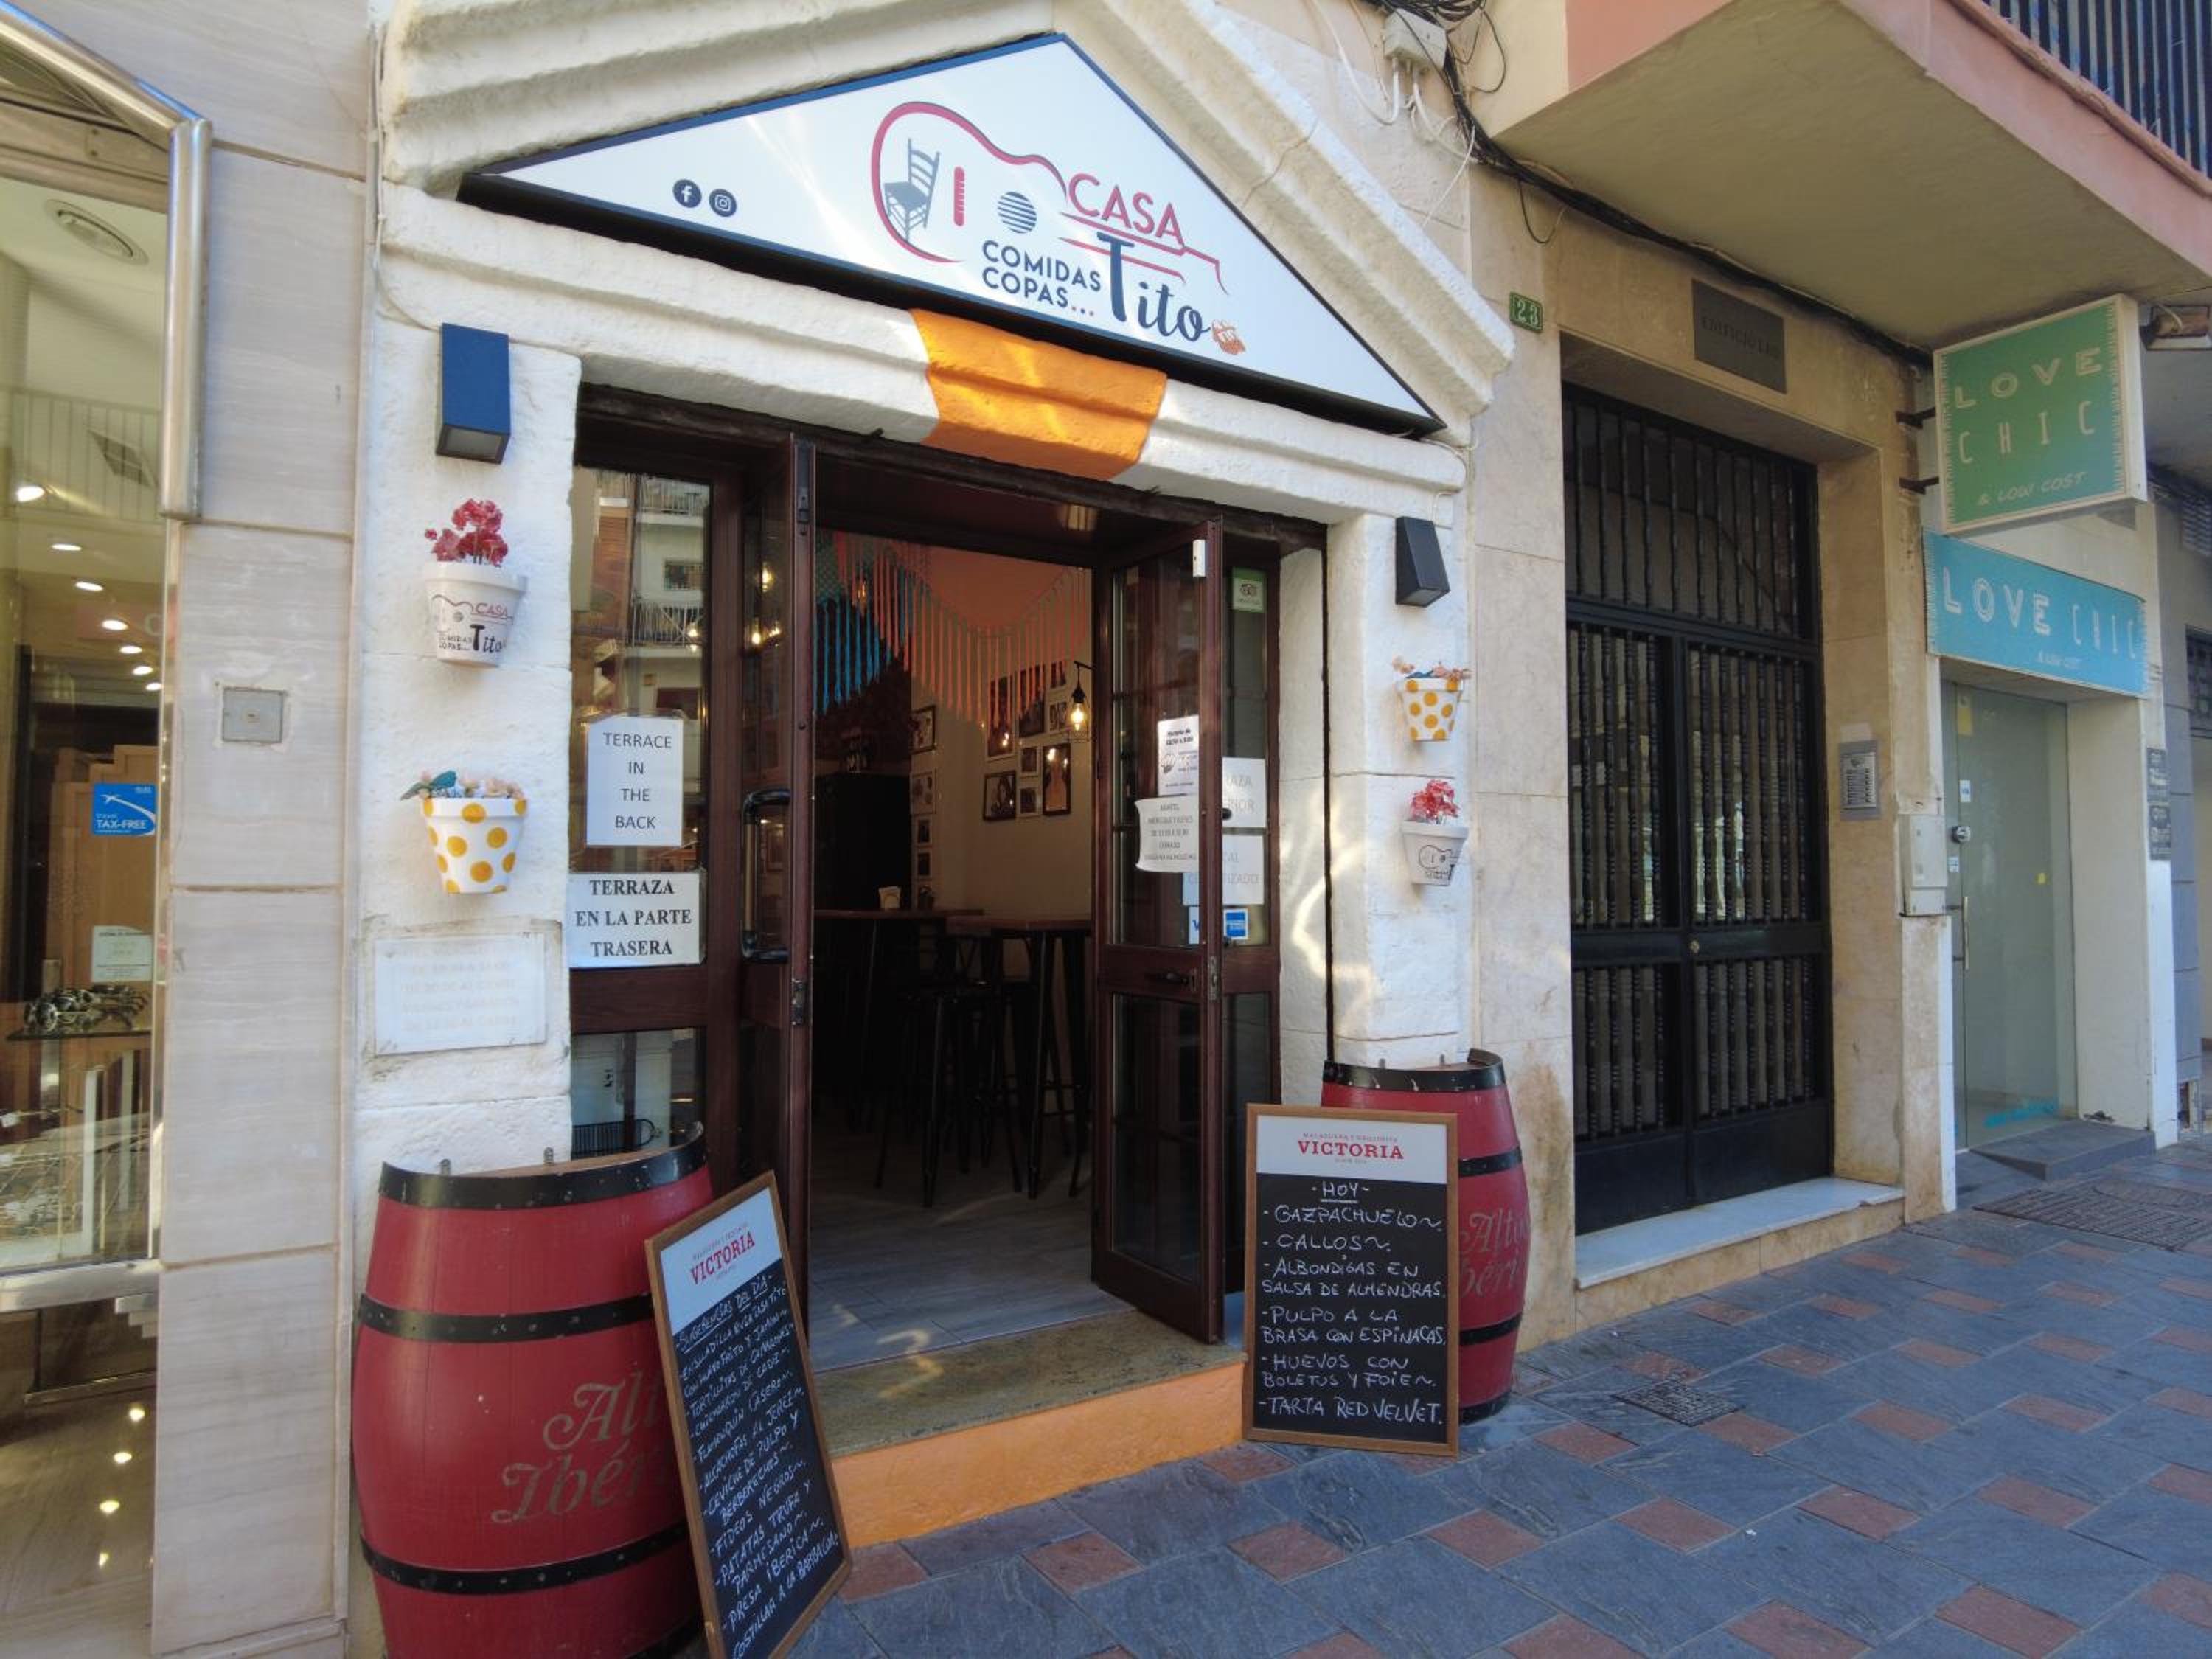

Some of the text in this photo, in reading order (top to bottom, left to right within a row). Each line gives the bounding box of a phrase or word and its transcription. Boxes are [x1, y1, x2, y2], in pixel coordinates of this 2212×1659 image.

[1069, 173, 1184, 248] CASA
[983, 240, 1101, 291] COMIDAS
[1096, 232, 1210, 341] Tito
[1955, 348, 2101, 409] LOVE
[1959, 401, 2095, 463] CHIC
[1997, 484, 2035, 503] LOW
[2040, 472, 2087, 493] COST
[476, 602, 508, 617] CASA
[1943, 566, 2137, 659] LOVE CHIC
[602, 732, 672, 748] TERRACE
[628, 762, 644, 774] IN
[620, 788, 650, 802] THE
[97, 819, 147, 830] TAX-FREE
[615, 815, 656, 830] BACK
[590, 879, 675, 896] TERRAZA
[575, 909, 692, 927] EN LA PARTE
[591, 940, 673, 958] TRASERA
[1298, 1141, 1404, 1160] VICTORIA
[1277, 1234, 1362, 1251] CALLOS
[691, 1231, 755, 1284] VICTORIA
[1387, 1262, 1418, 1276] EN
[1262, 1279, 1312, 1295] SALSA
[1321, 1281, 1339, 1295] DE
[1345, 1309, 1357, 1322] A
[1370, 1309, 1399, 1322] LA
[1262, 1326, 1318, 1343] BRASA
[1327, 1329, 1354, 1343] CON
[1274, 1353, 1409, 1371] HUEVOS CON
[1347, 1373, 1357, 1388] Y
[1334, 1396, 1368, 1419] RED
[728, 1580, 762, 1633] PRESA
